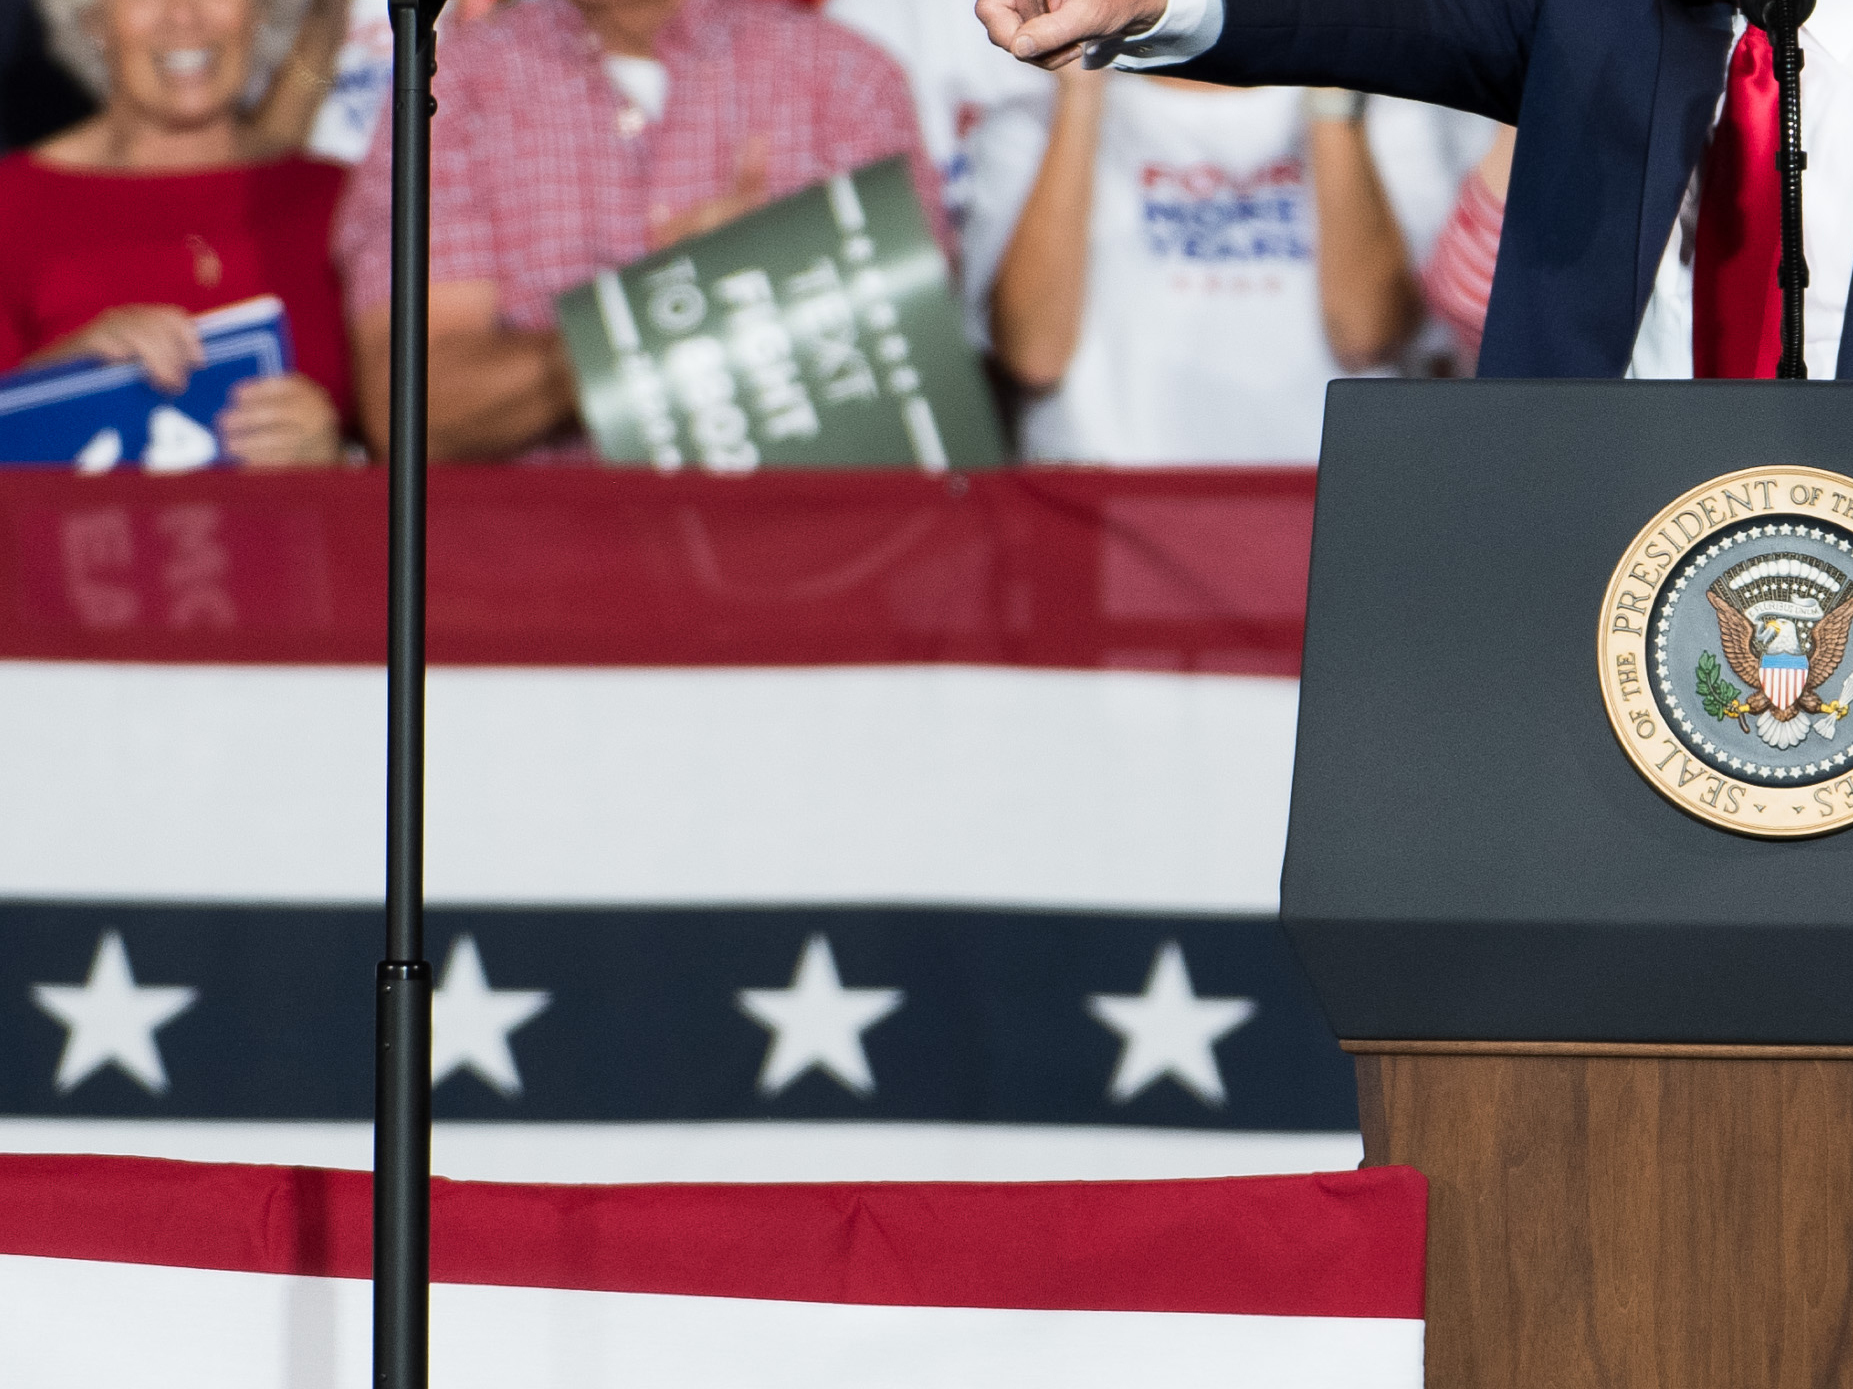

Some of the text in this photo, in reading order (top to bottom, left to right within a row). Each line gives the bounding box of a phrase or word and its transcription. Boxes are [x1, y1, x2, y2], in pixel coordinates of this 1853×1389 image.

[648, 257, 708, 333] TO
[786, 256, 878, 401] TEXT
[1790, 483, 1823, 507] OF
[1613, 478, 1777, 637] PRESIDENT
[1616, 652, 1642, 703] THE
[1630, 707, 1657, 740] OF
[1655, 738, 1747, 814] SEAL
